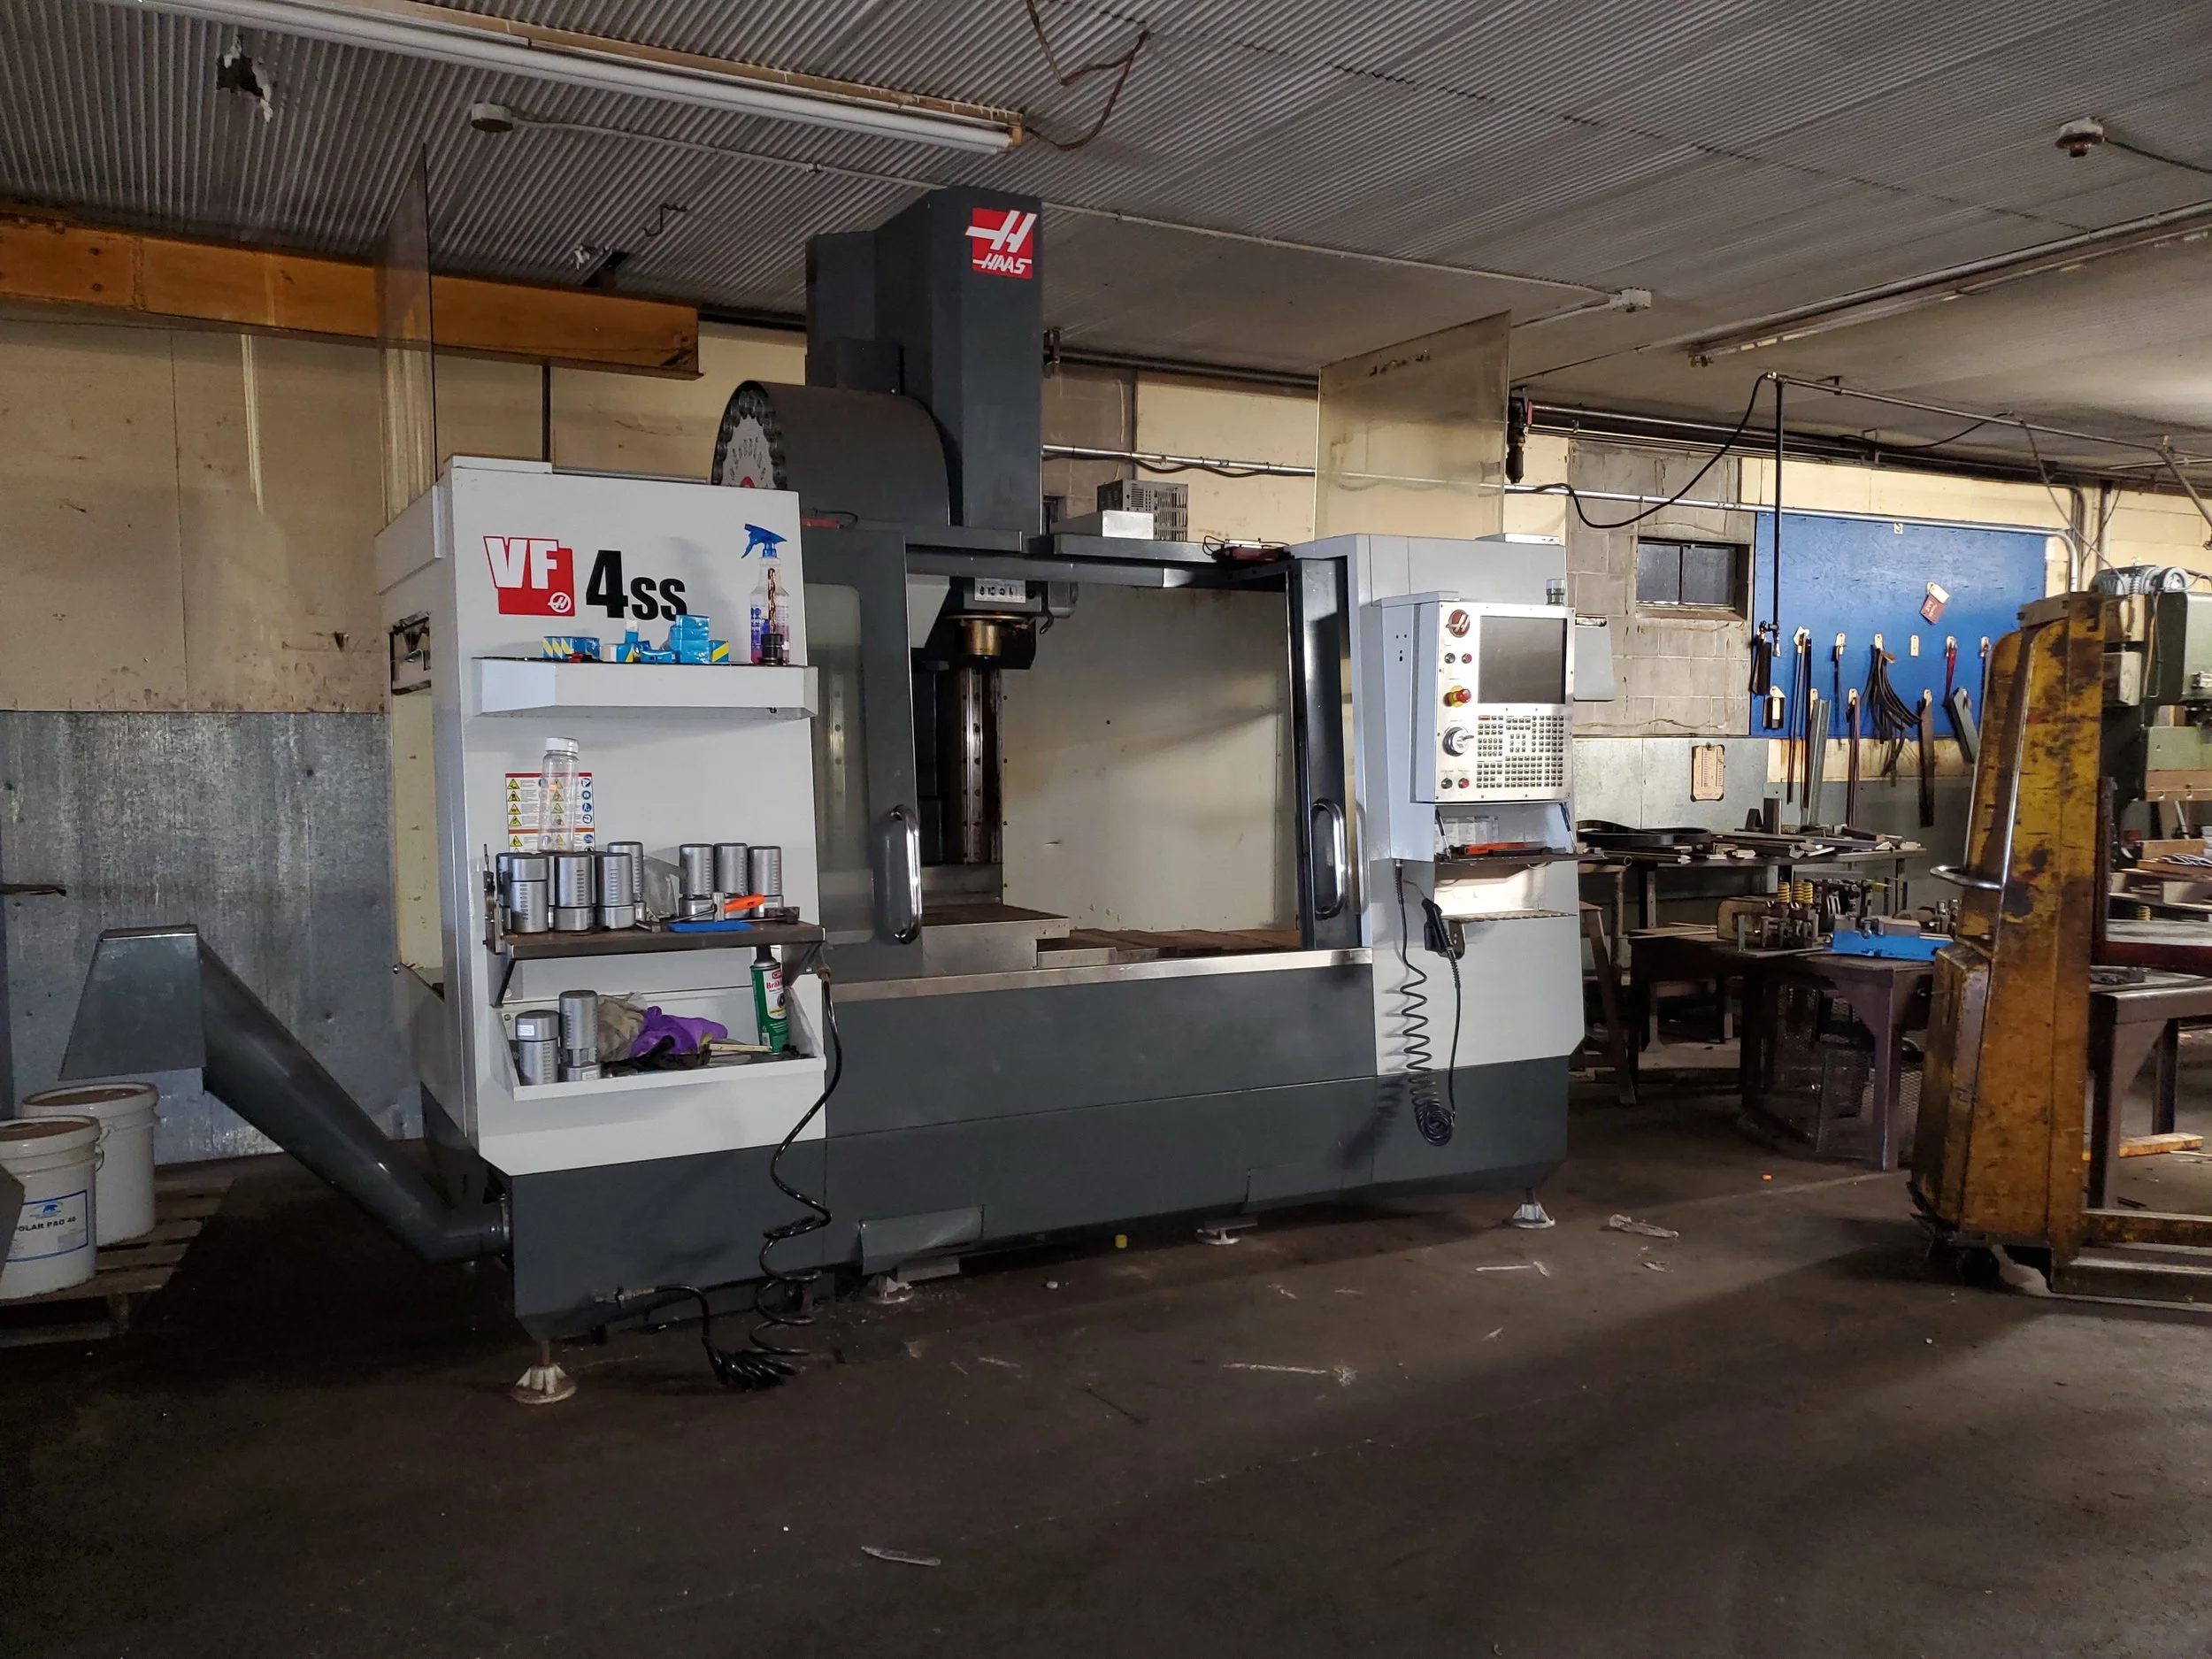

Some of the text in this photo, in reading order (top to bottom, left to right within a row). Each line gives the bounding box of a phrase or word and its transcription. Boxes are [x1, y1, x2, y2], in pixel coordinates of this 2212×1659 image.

[972, 252, 1033, 274] HAAS
[483, 536, 558, 589] VF
[16, 1223, 44, 1232] OLAR
